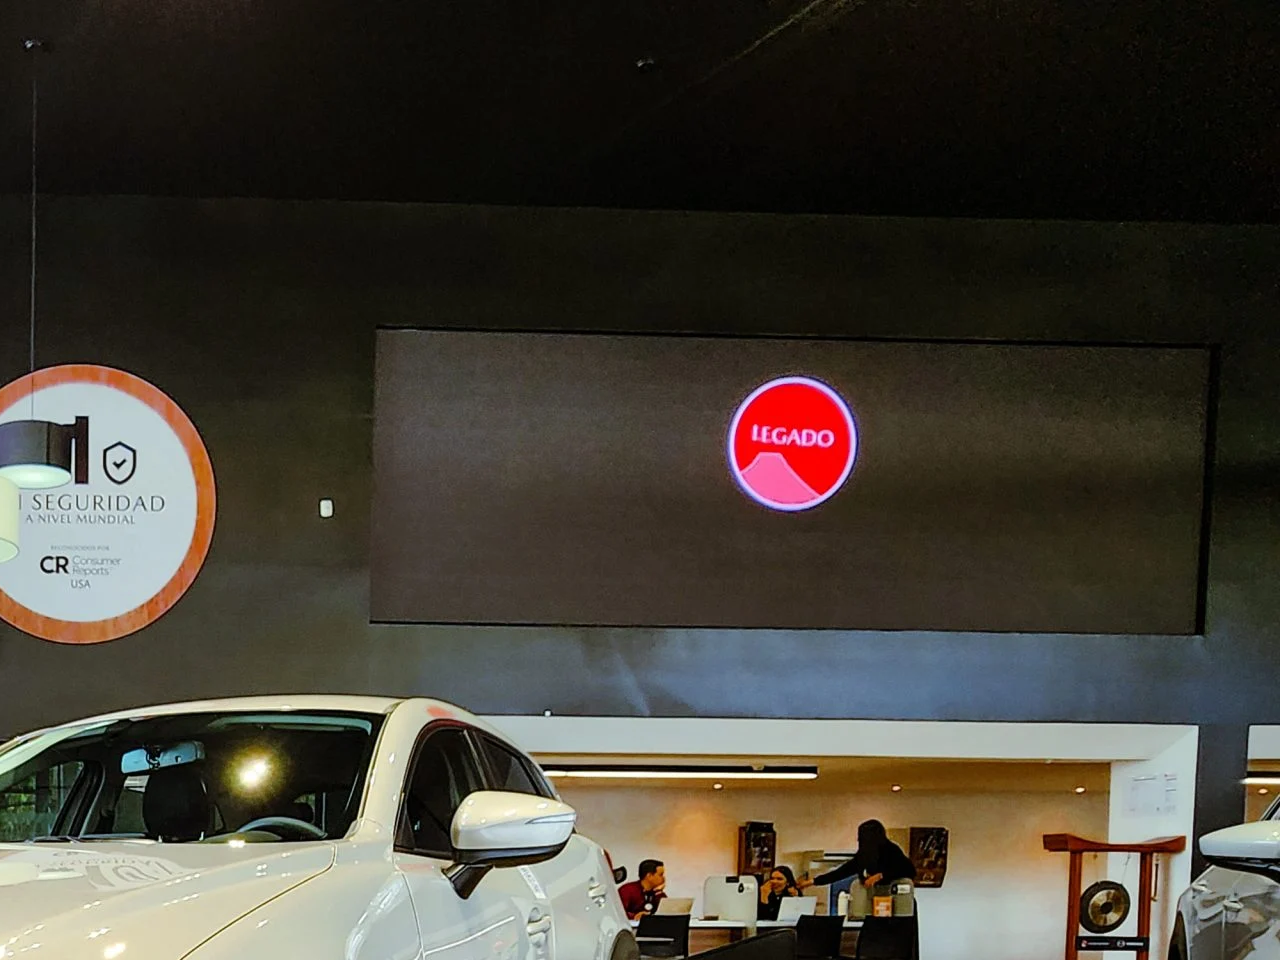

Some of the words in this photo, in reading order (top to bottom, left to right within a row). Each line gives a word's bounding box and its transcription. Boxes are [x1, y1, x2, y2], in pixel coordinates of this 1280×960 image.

[751, 423, 835, 448] LEGADO
[31, 493, 166, 512] SEGURIDAD
[25, 514, 34, 524] A
[38, 514, 71, 524] NIVEL
[76, 514, 135, 525] MUNDIAL
[39, 555, 69, 574] CR
[72, 555, 121, 566] Consumer
[72, 566, 110, 576] Reports
[70, 580, 91, 589] USA
